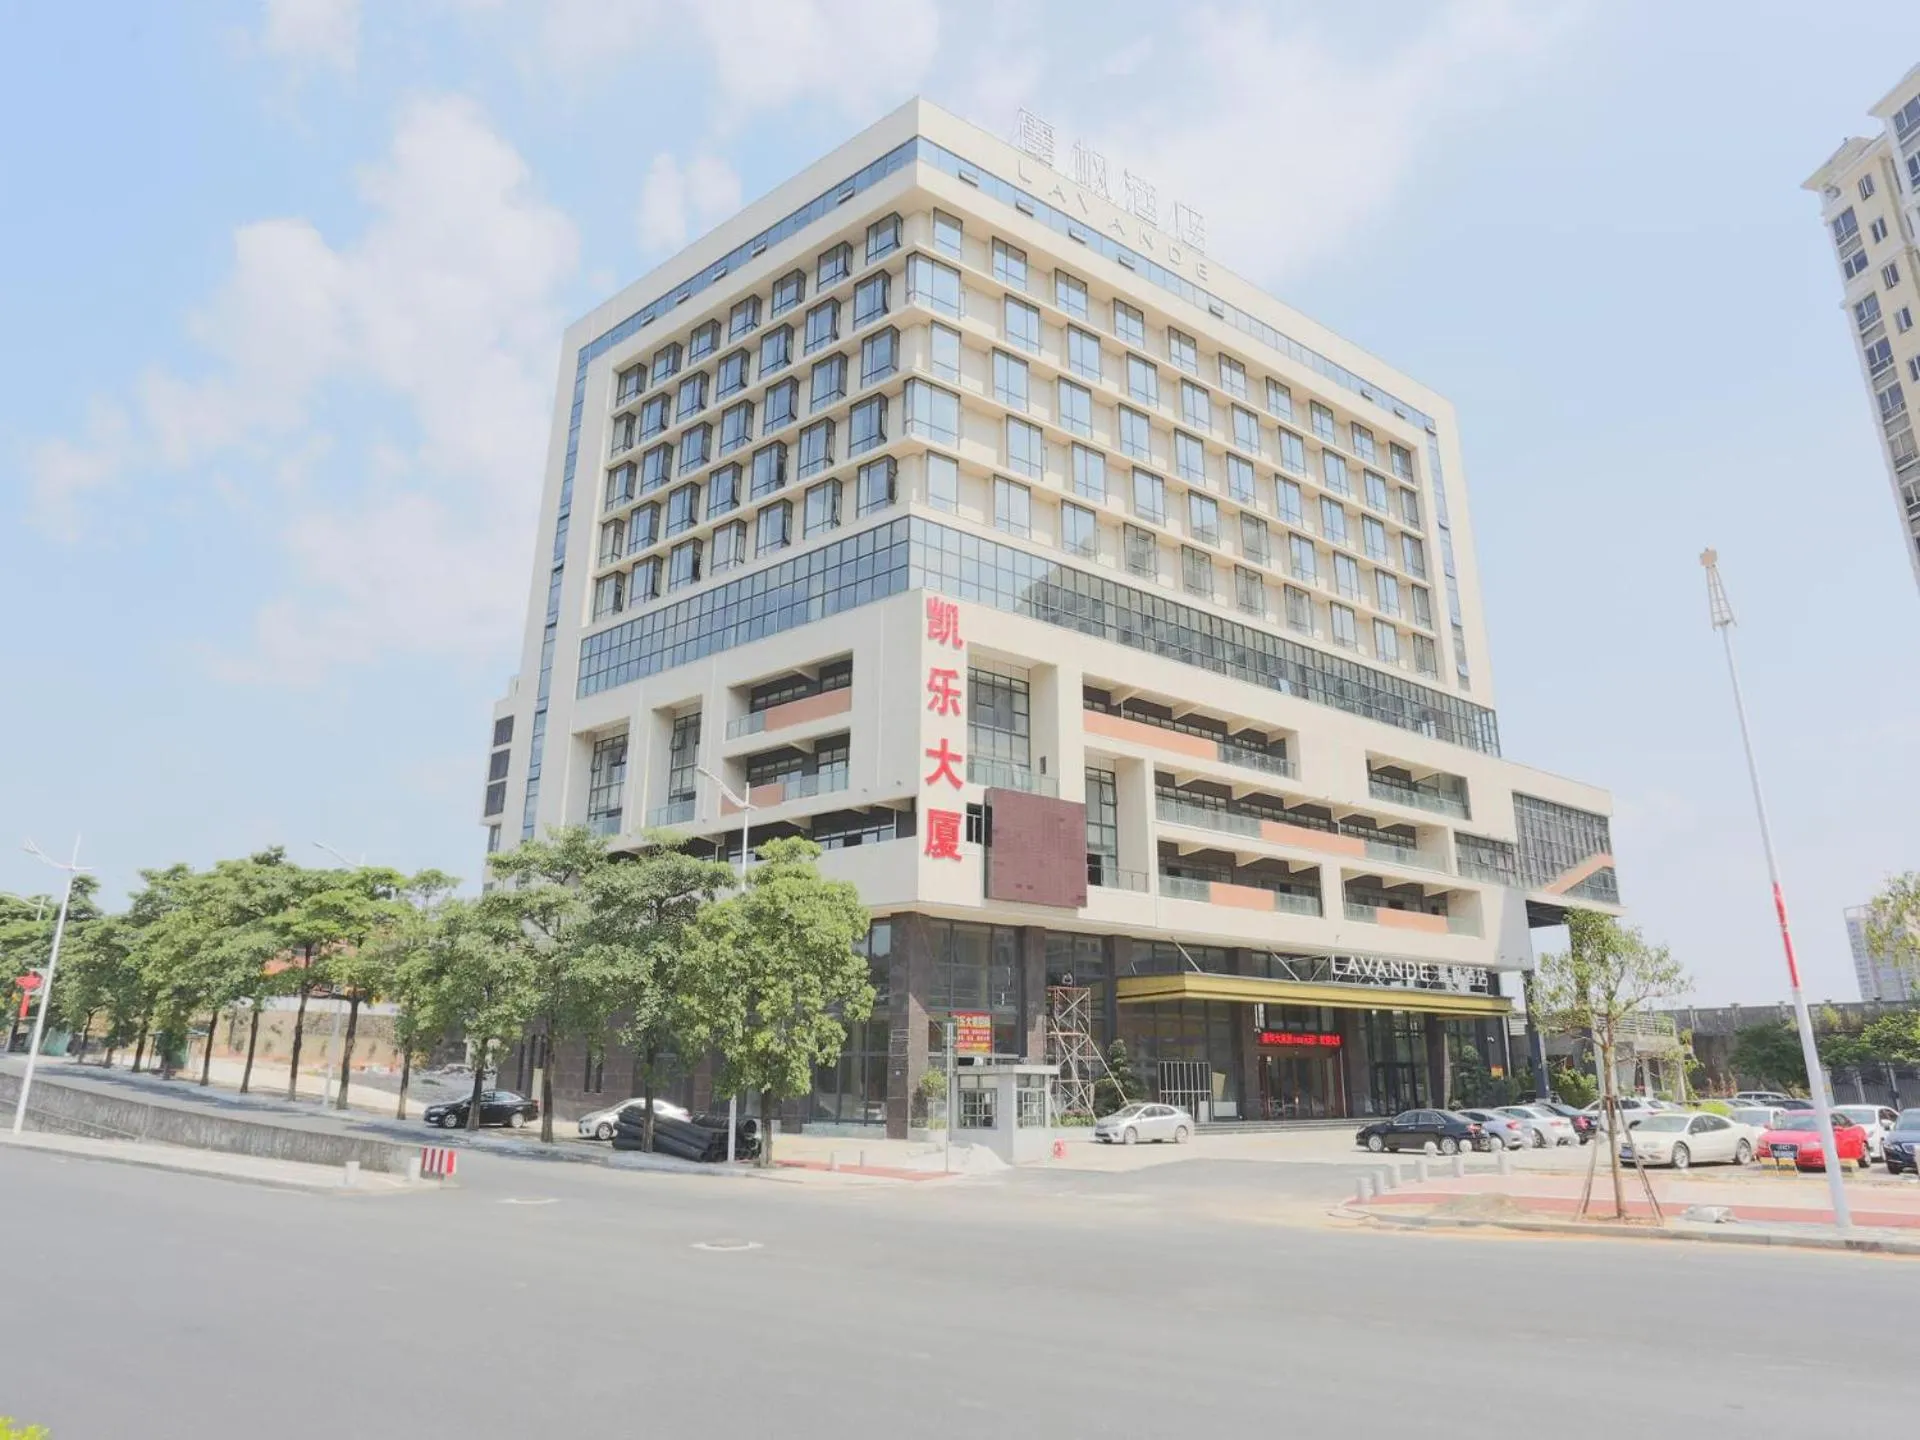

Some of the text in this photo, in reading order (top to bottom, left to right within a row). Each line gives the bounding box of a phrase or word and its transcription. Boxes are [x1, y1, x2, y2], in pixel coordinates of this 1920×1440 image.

[924, 596, 964, 862] 凯乐大厦
[1332, 953, 1430, 983] LAVANDE
